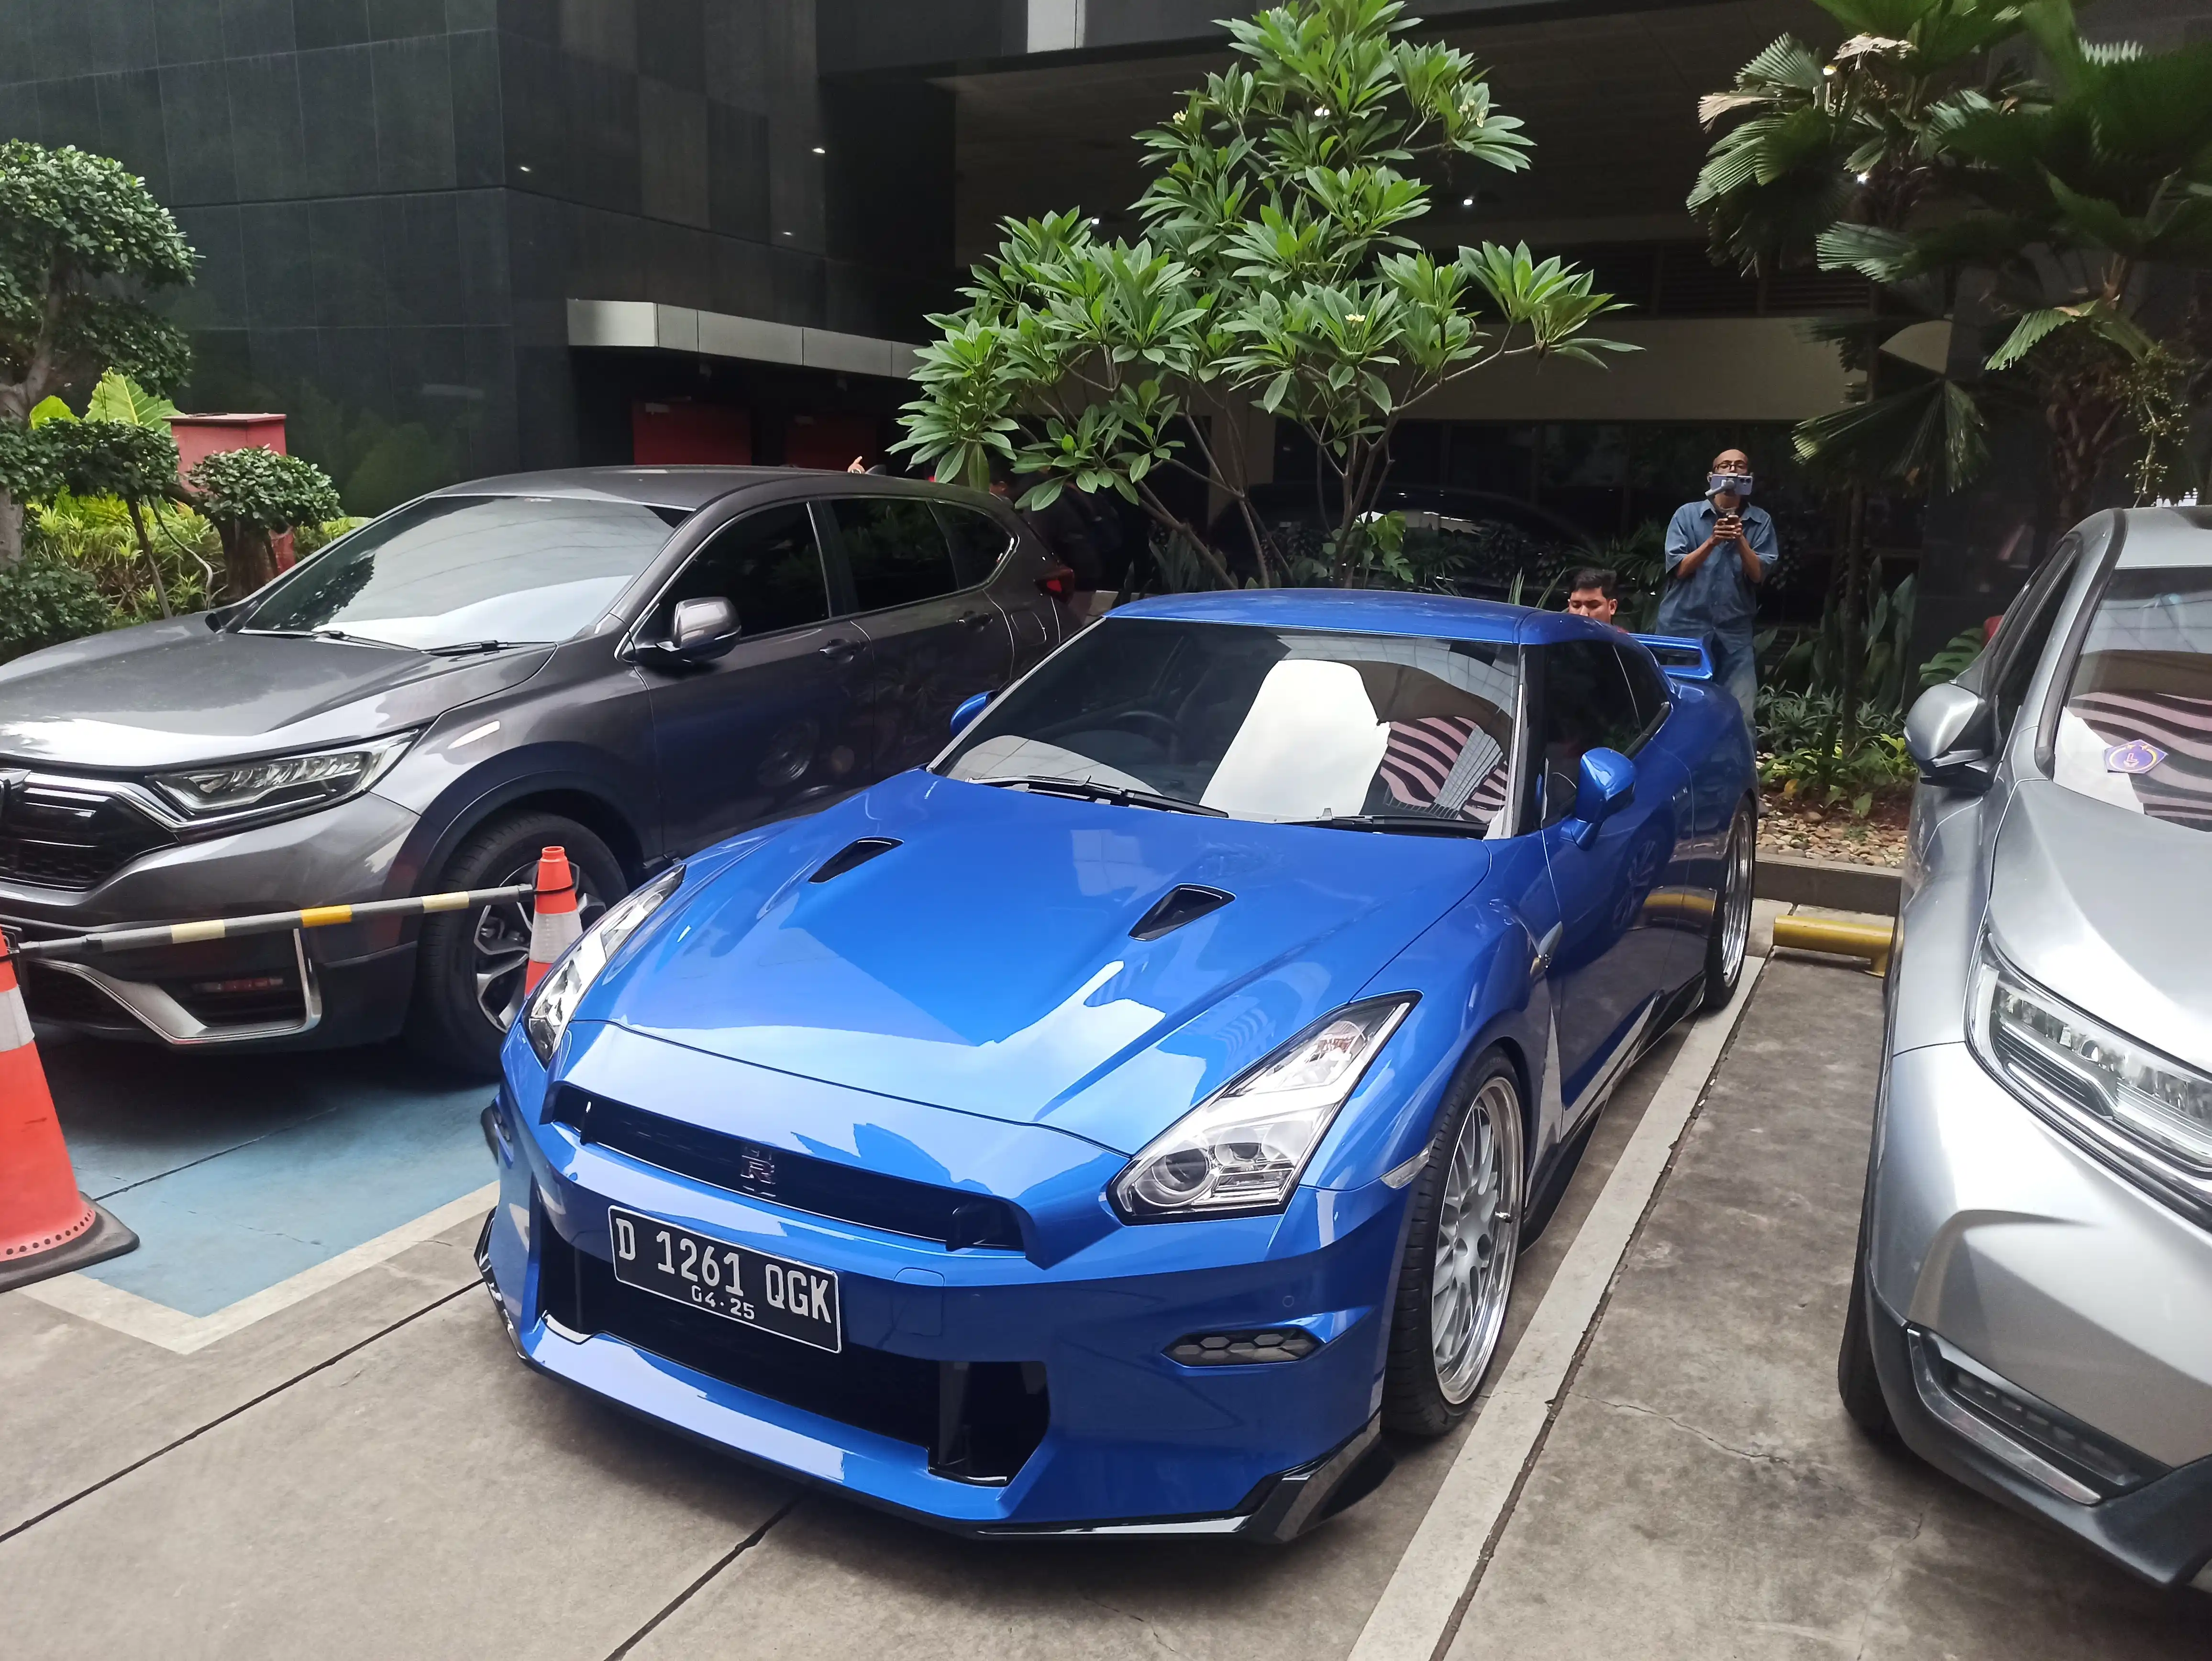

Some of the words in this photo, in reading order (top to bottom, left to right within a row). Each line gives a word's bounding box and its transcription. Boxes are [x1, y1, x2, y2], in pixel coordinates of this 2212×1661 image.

[616, 1218, 636, 1261] D
[656, 1230, 743, 1296] 1261
[765, 1264, 831, 1324] QGK
